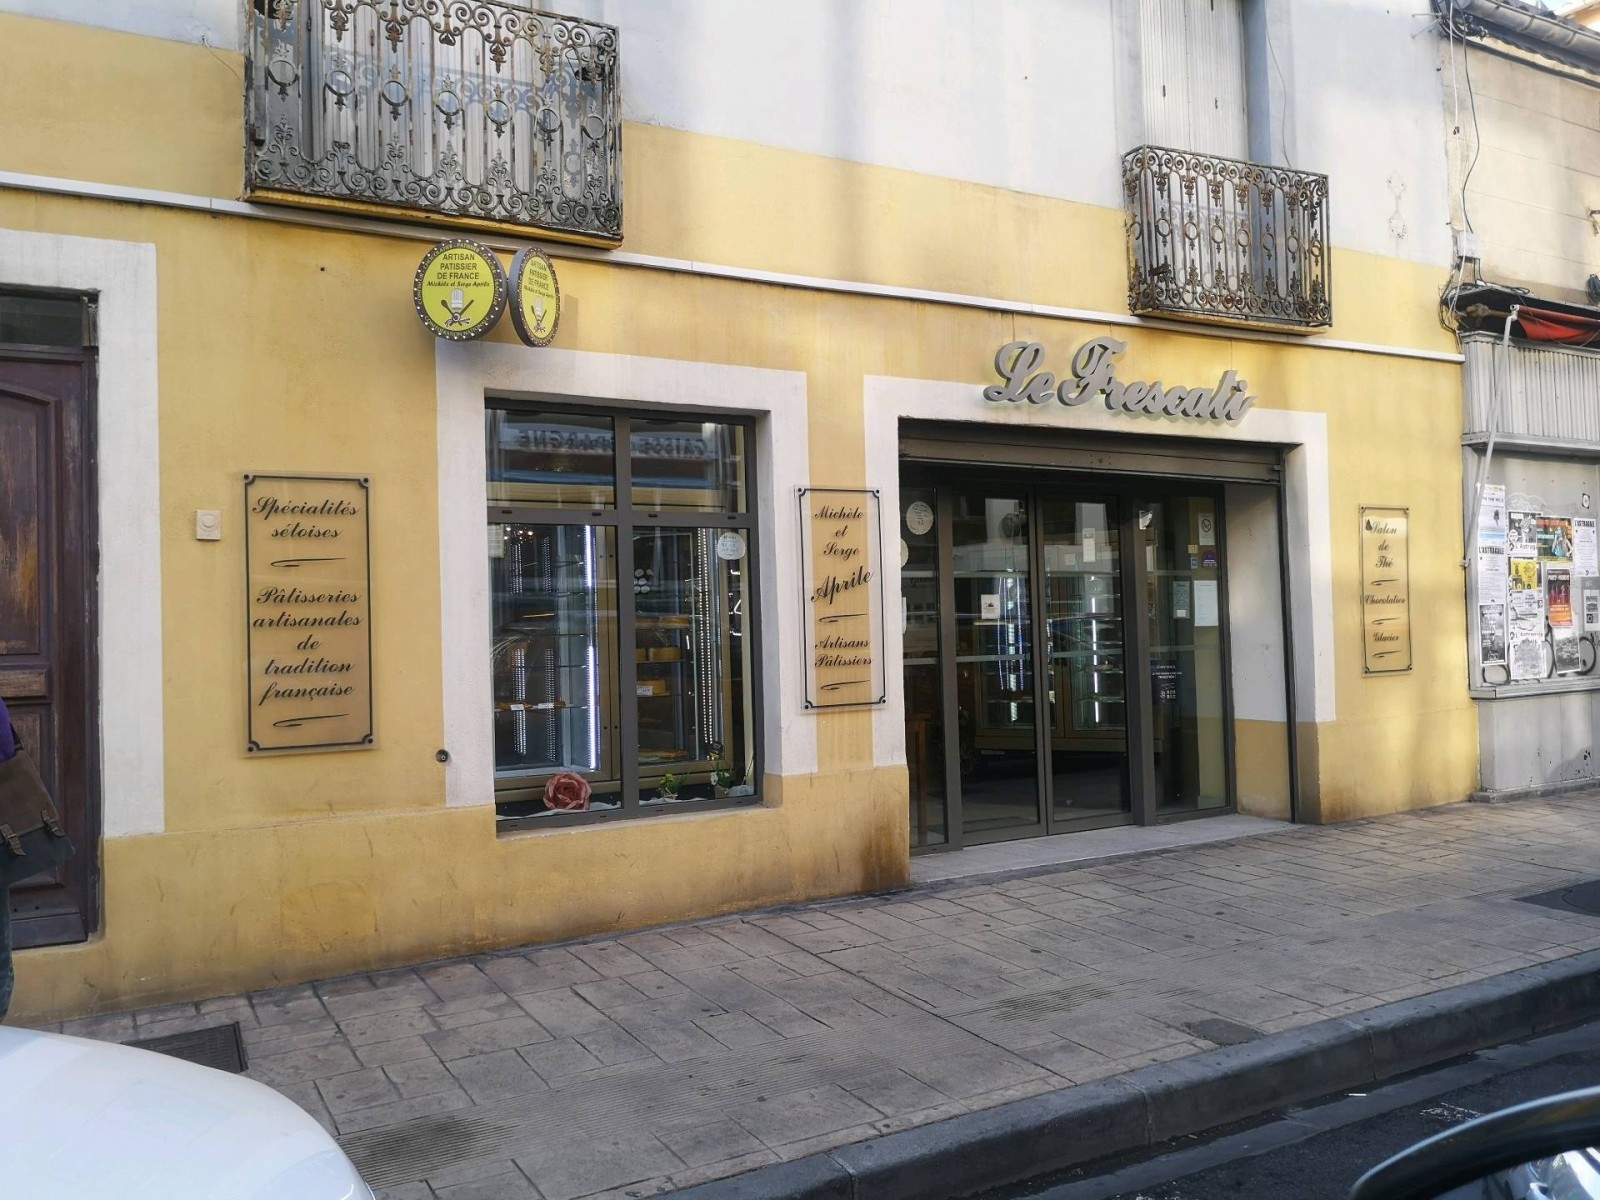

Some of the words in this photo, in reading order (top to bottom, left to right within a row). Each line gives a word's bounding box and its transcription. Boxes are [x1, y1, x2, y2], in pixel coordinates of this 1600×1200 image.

[437, 272, 448, 280] DE
[449, 272, 480, 280] FRANCE
[983, 340, 1055, 404] Le
[1056, 336, 1257, 421] Frescati
[252, 496, 360, 520] Spécialités
[814, 505, 864, 519] Michèle
[271, 522, 341, 538] sétoises
[835, 525, 848, 538] et
[823, 542, 860, 561] Serge
[1378, 539, 1390, 551] de
[1479, 546, 1504, 555] L'ASTRAGALE
[1376, 555, 1393, 568] Thé
[811, 565, 874, 605] Aprile
[256, 586, 360, 604] Pâtisseries
[253, 610, 361, 628] artisanales
[297, 634, 321, 650] de
[815, 635, 870, 649] Artisans
[264, 657, 353, 675] tradition
[815, 654, 873, 668] Pâtissiers
[258, 682, 354, 706] française
